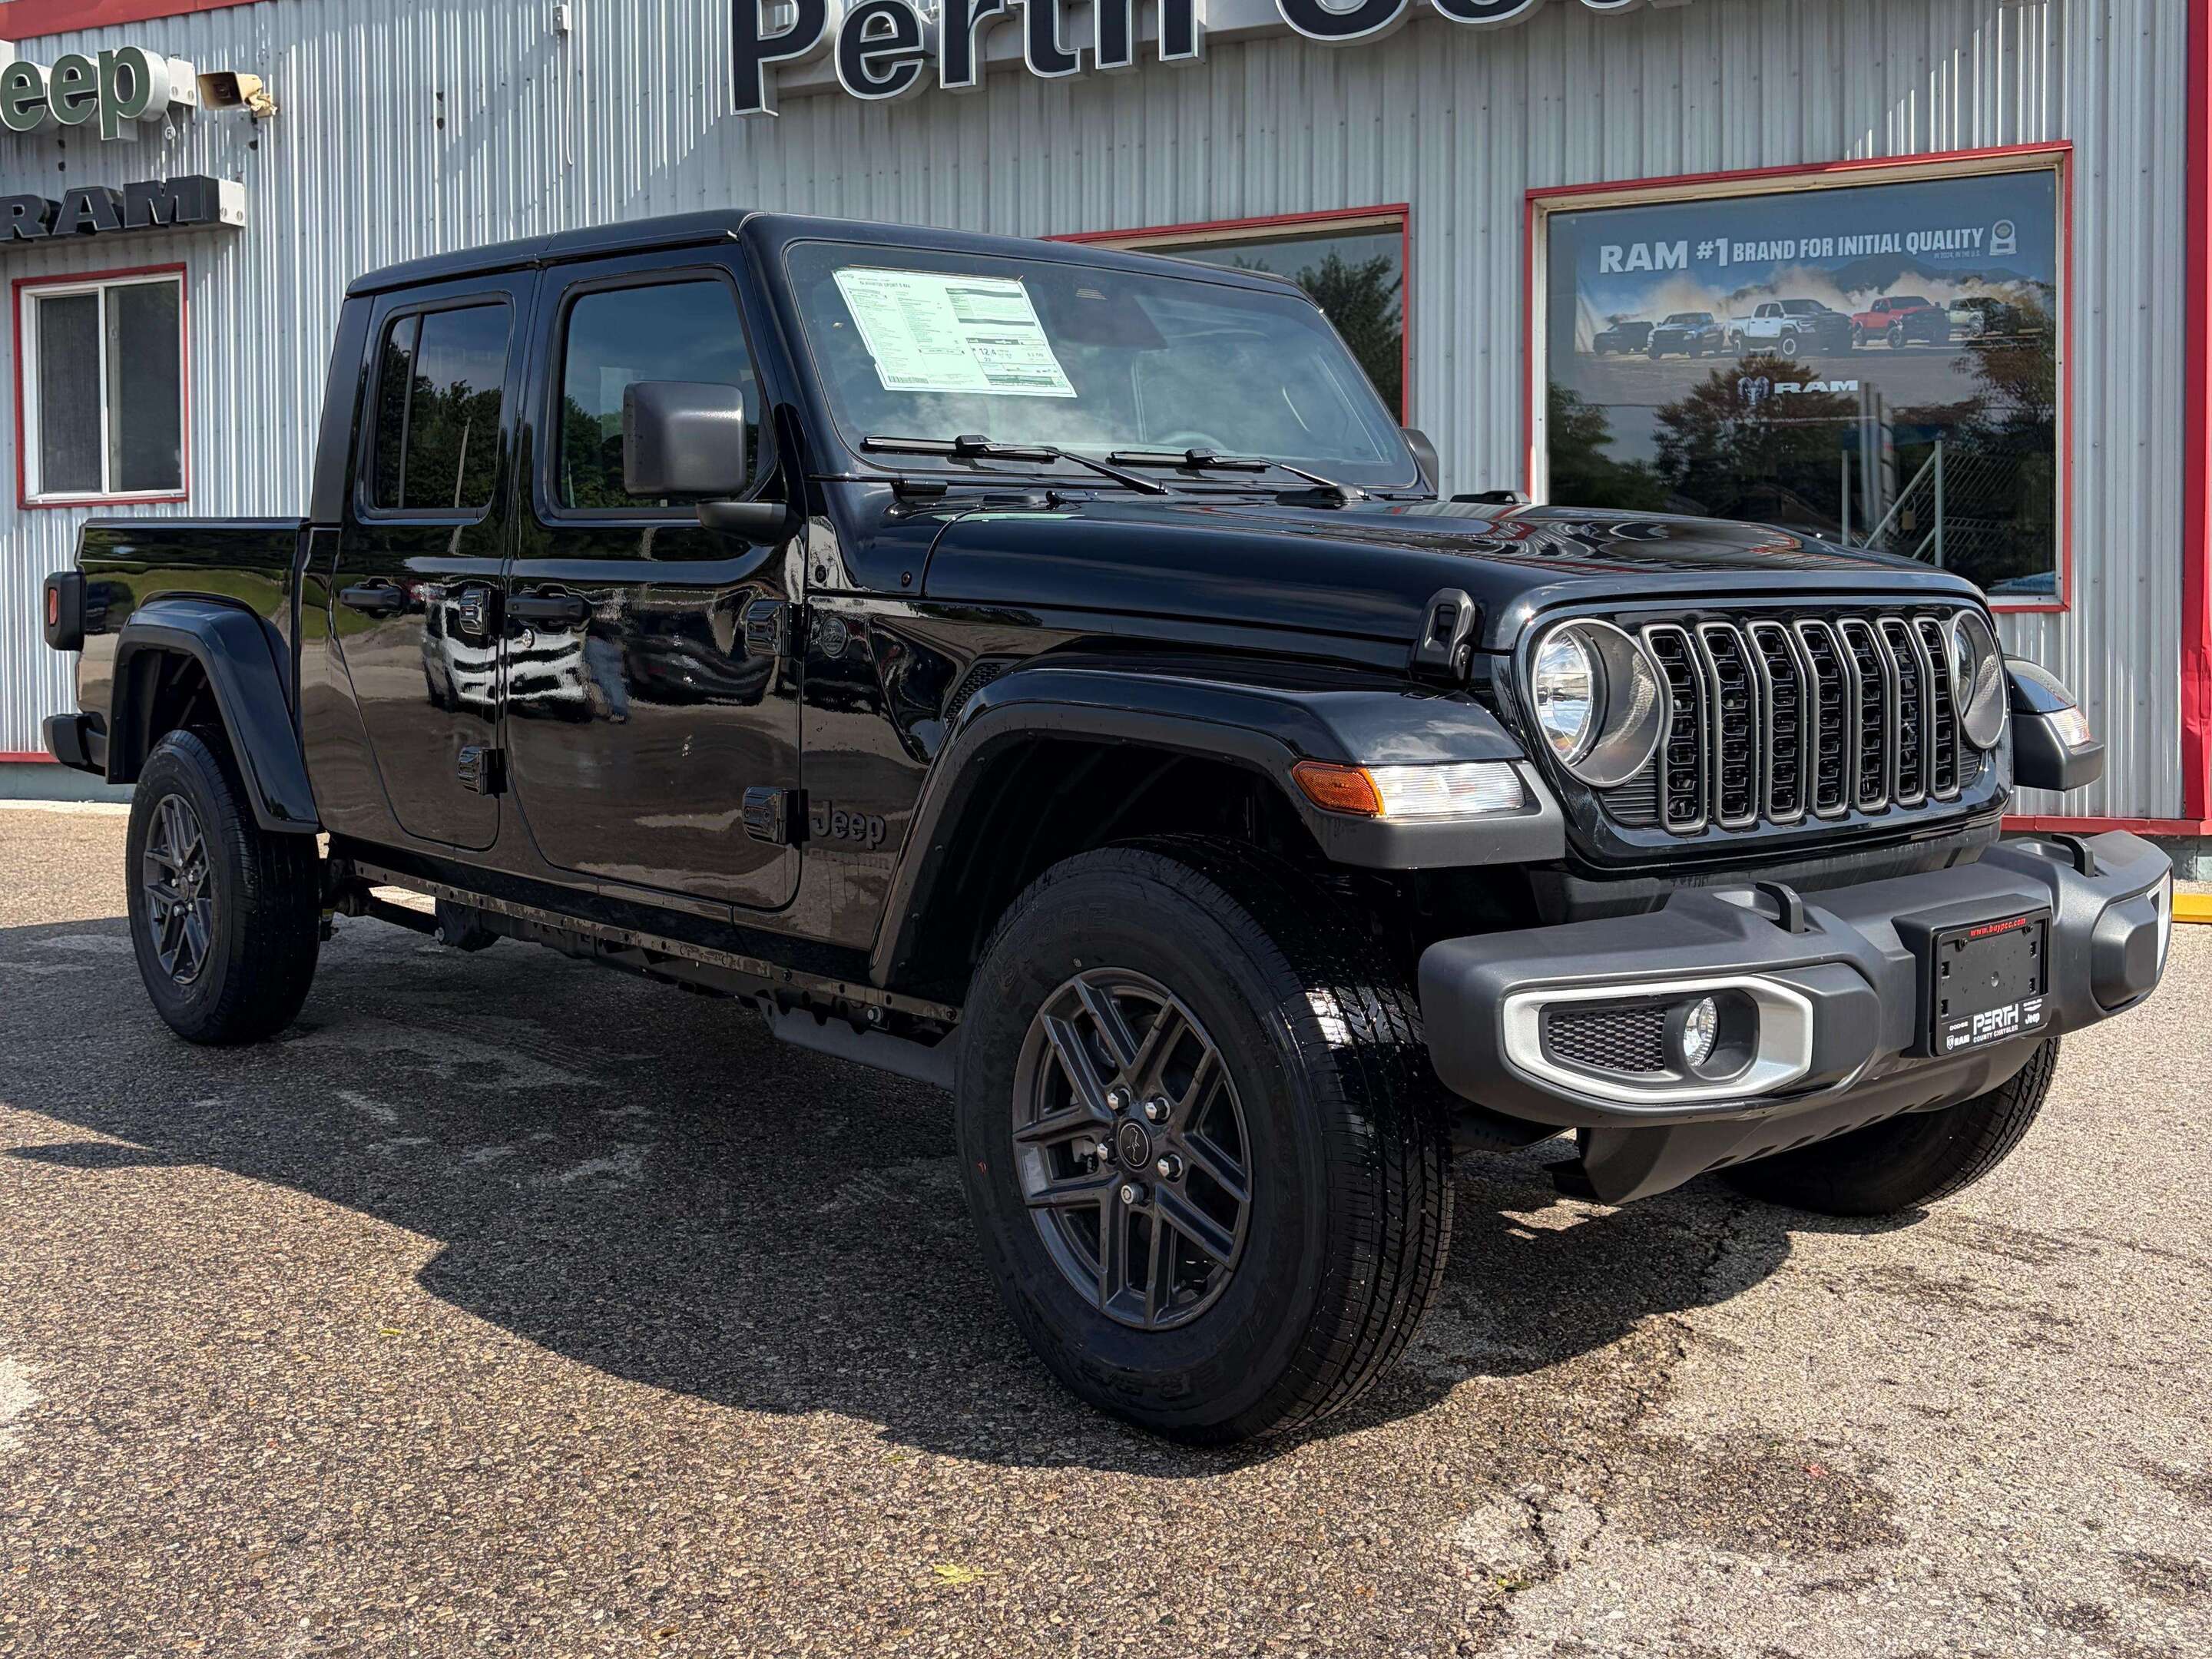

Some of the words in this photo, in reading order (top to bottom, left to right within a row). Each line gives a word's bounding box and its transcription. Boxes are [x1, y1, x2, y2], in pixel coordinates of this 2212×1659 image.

[0, 46, 151, 141] eep
[0, 175, 203, 241] RAM
[1600, 240, 1688, 273] RAM
[1696, 238, 1728, 267] #1
[1733, 240, 1795, 262] BRAND
[1800, 237, 1833, 259] FOR
[1838, 233, 1902, 256] INITIAL
[1906, 227, 1984, 255] QUALITY
[1774, 380, 1858, 394] RAM
[810, 800, 886, 850] Jeep
[1973, 1003, 2018, 1035] PERTH
[2025, 1013, 2041, 1025] Jeep
[1955, 1034, 1970, 1046] RAM
[1973, 1031, 1992, 1043] COUNTY
